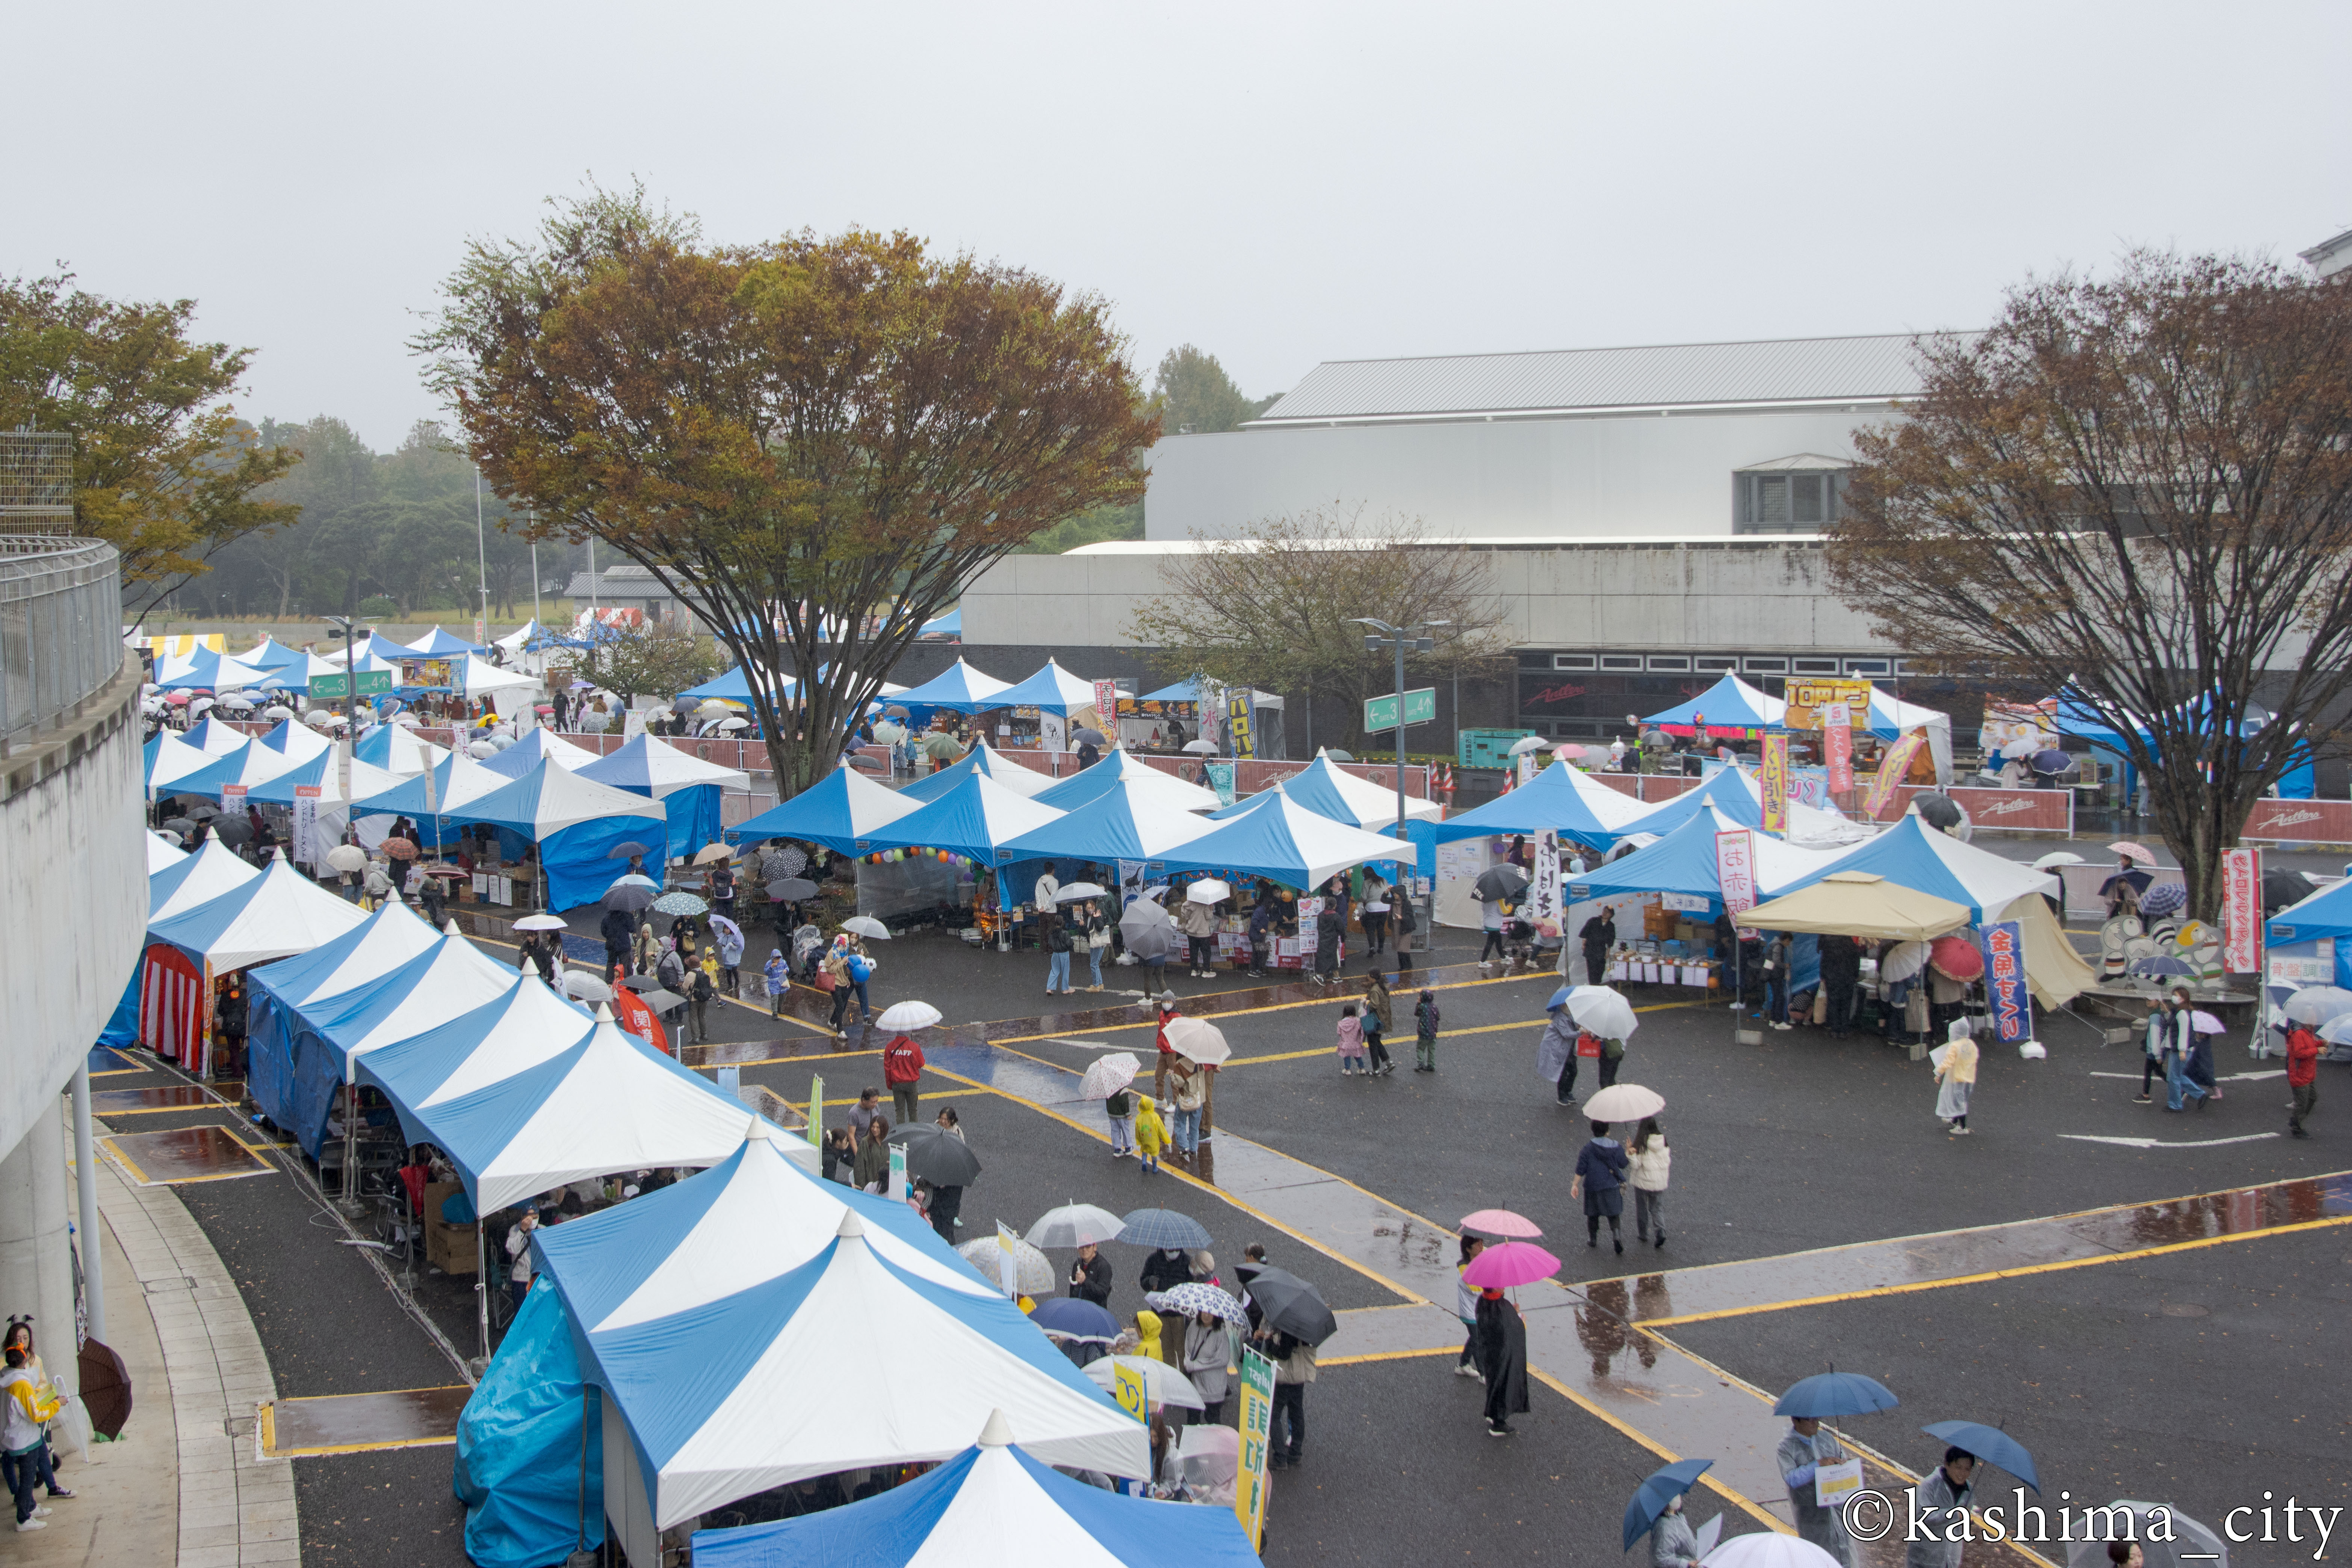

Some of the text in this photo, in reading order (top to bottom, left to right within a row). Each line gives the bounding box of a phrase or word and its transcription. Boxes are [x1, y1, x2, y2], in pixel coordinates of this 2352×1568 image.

[339, 679, 346, 691] 3
[372, 676, 378, 688] 4
[1390, 703, 1397, 719] 3
[1417, 698, 1424, 714] 4
[1765, 748, 1779, 814] くじ引き
[1977, 798, 2038, 818] Antlers
[2256, 810, 2324, 830] Antlers
[2271, 962, 2332, 977] 骨盤調整
